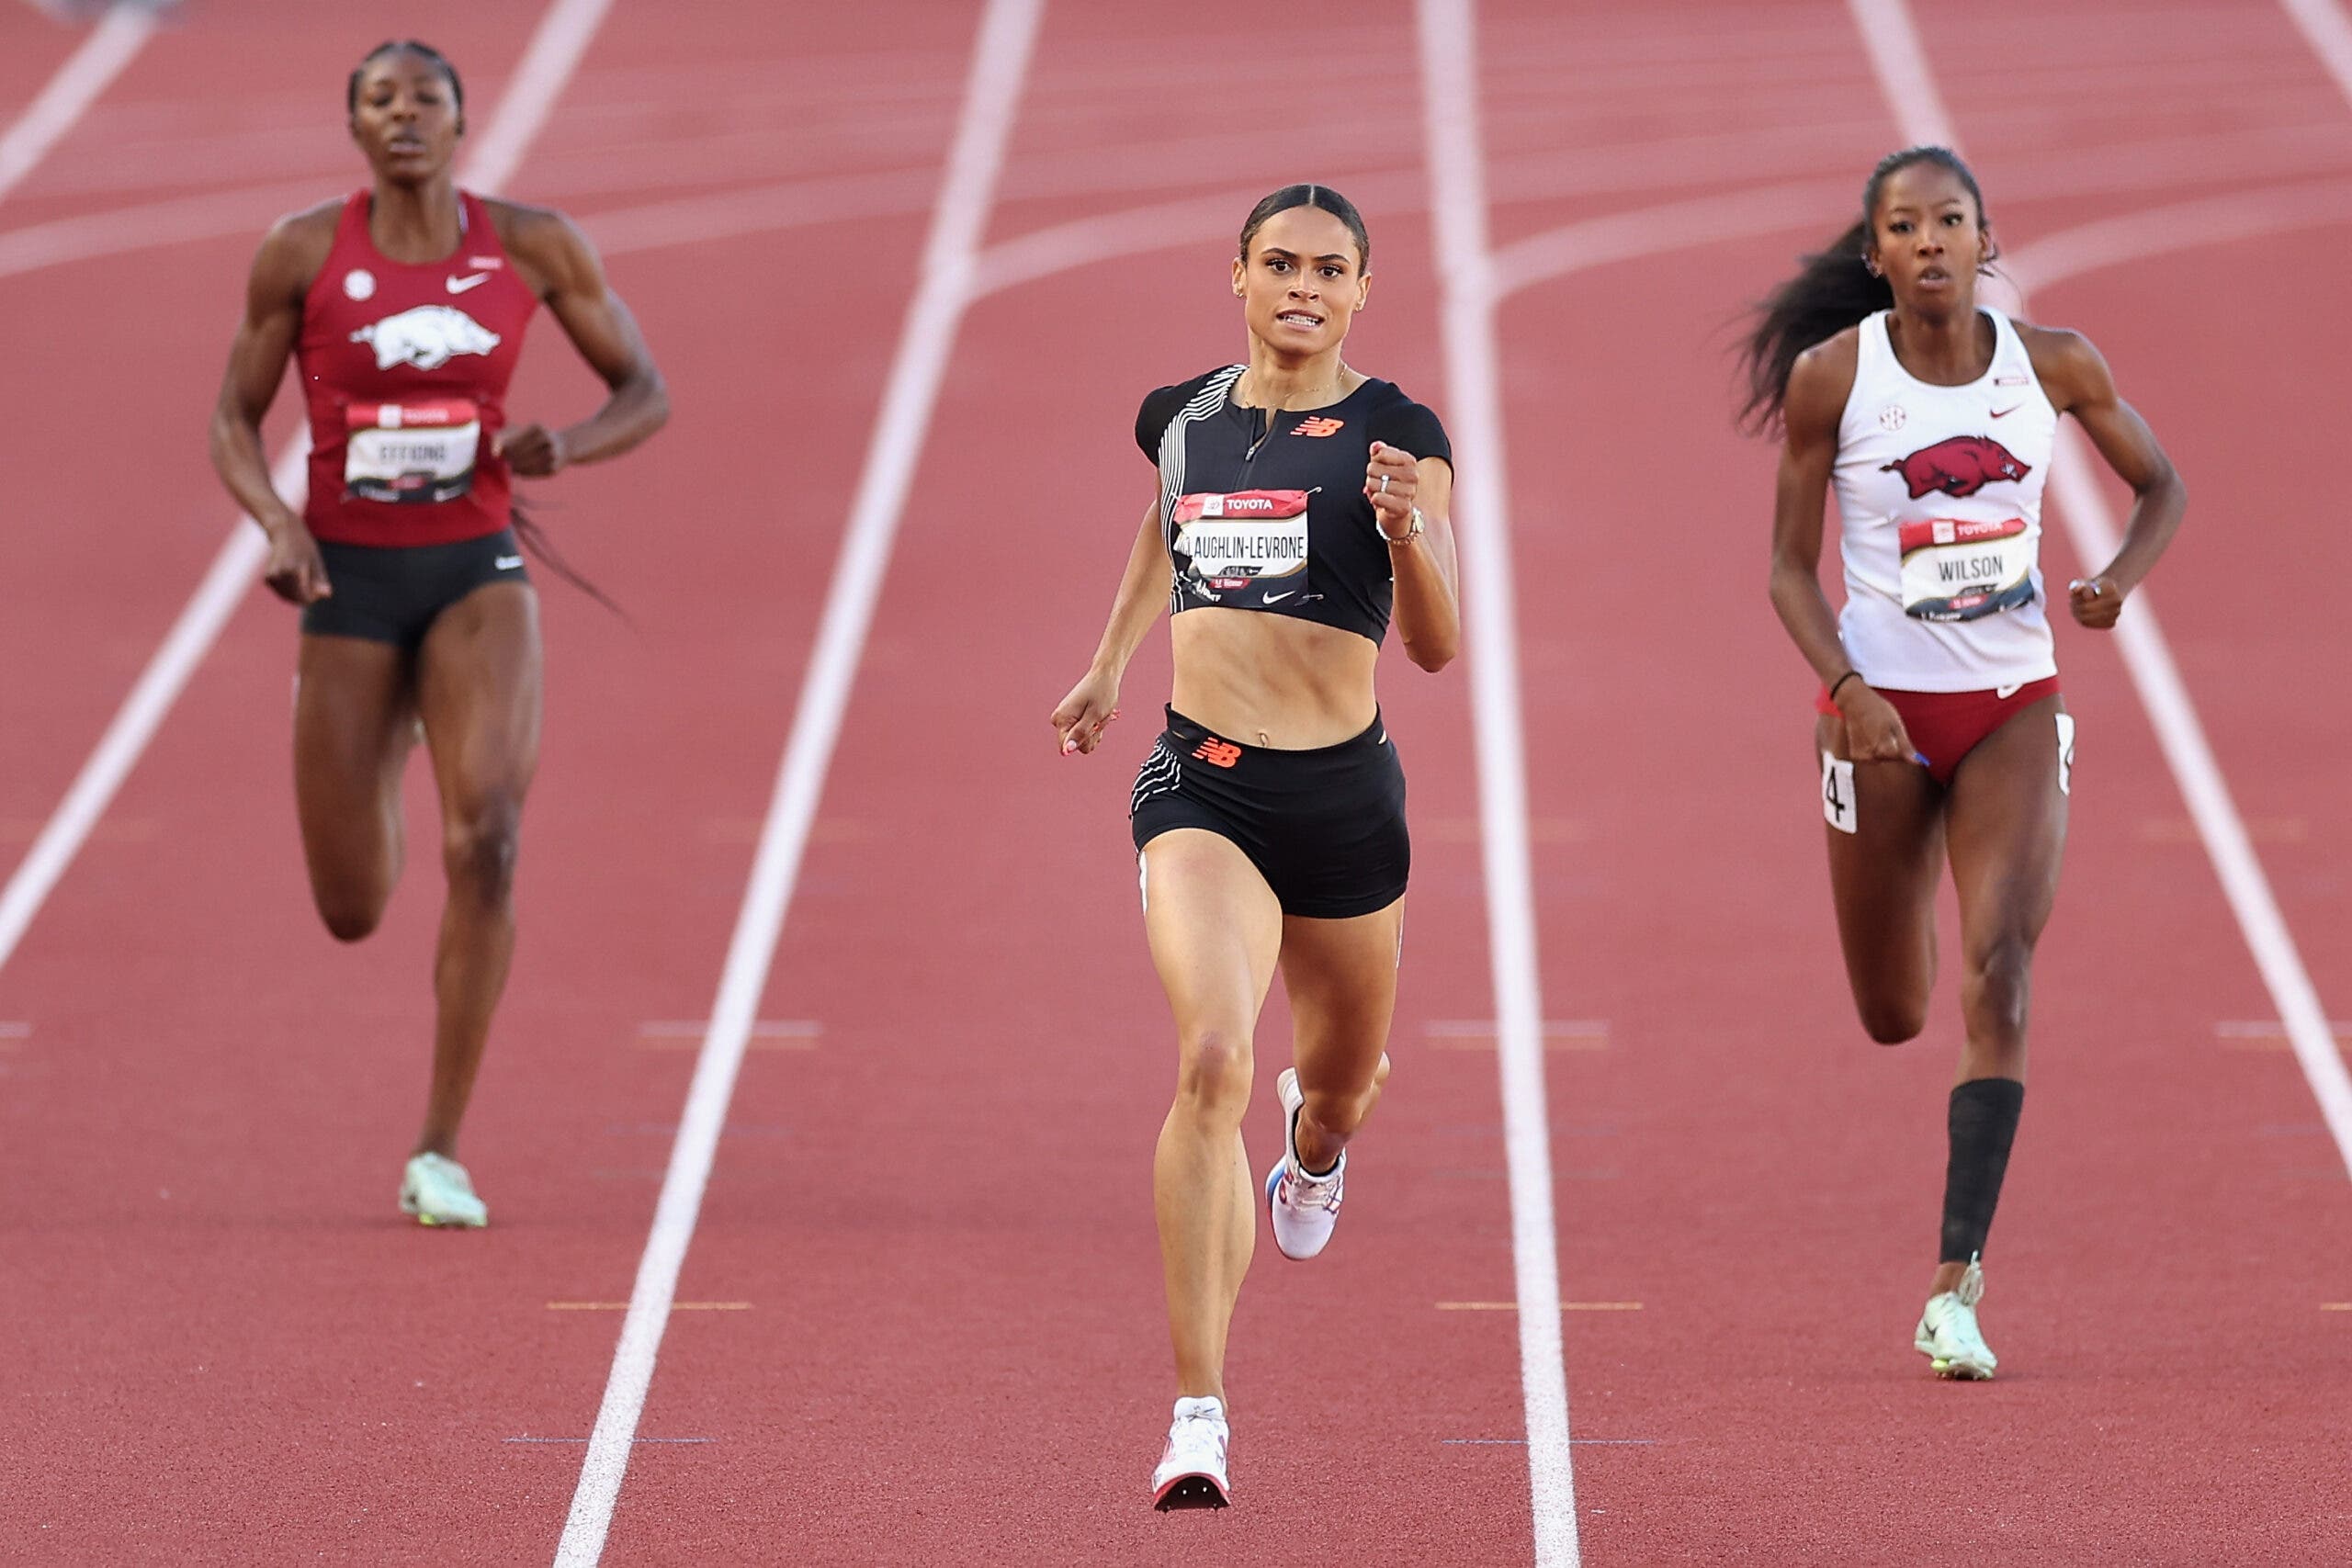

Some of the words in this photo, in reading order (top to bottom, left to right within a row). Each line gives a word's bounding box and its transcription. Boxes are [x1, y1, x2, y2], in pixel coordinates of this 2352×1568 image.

[1227, 499, 1273, 511] TOYOTA
[1957, 522, 2004, 536] TOYOTA
[1939, 555, 2004, 581] WILSON
[1826, 765, 1845, 823] 4
